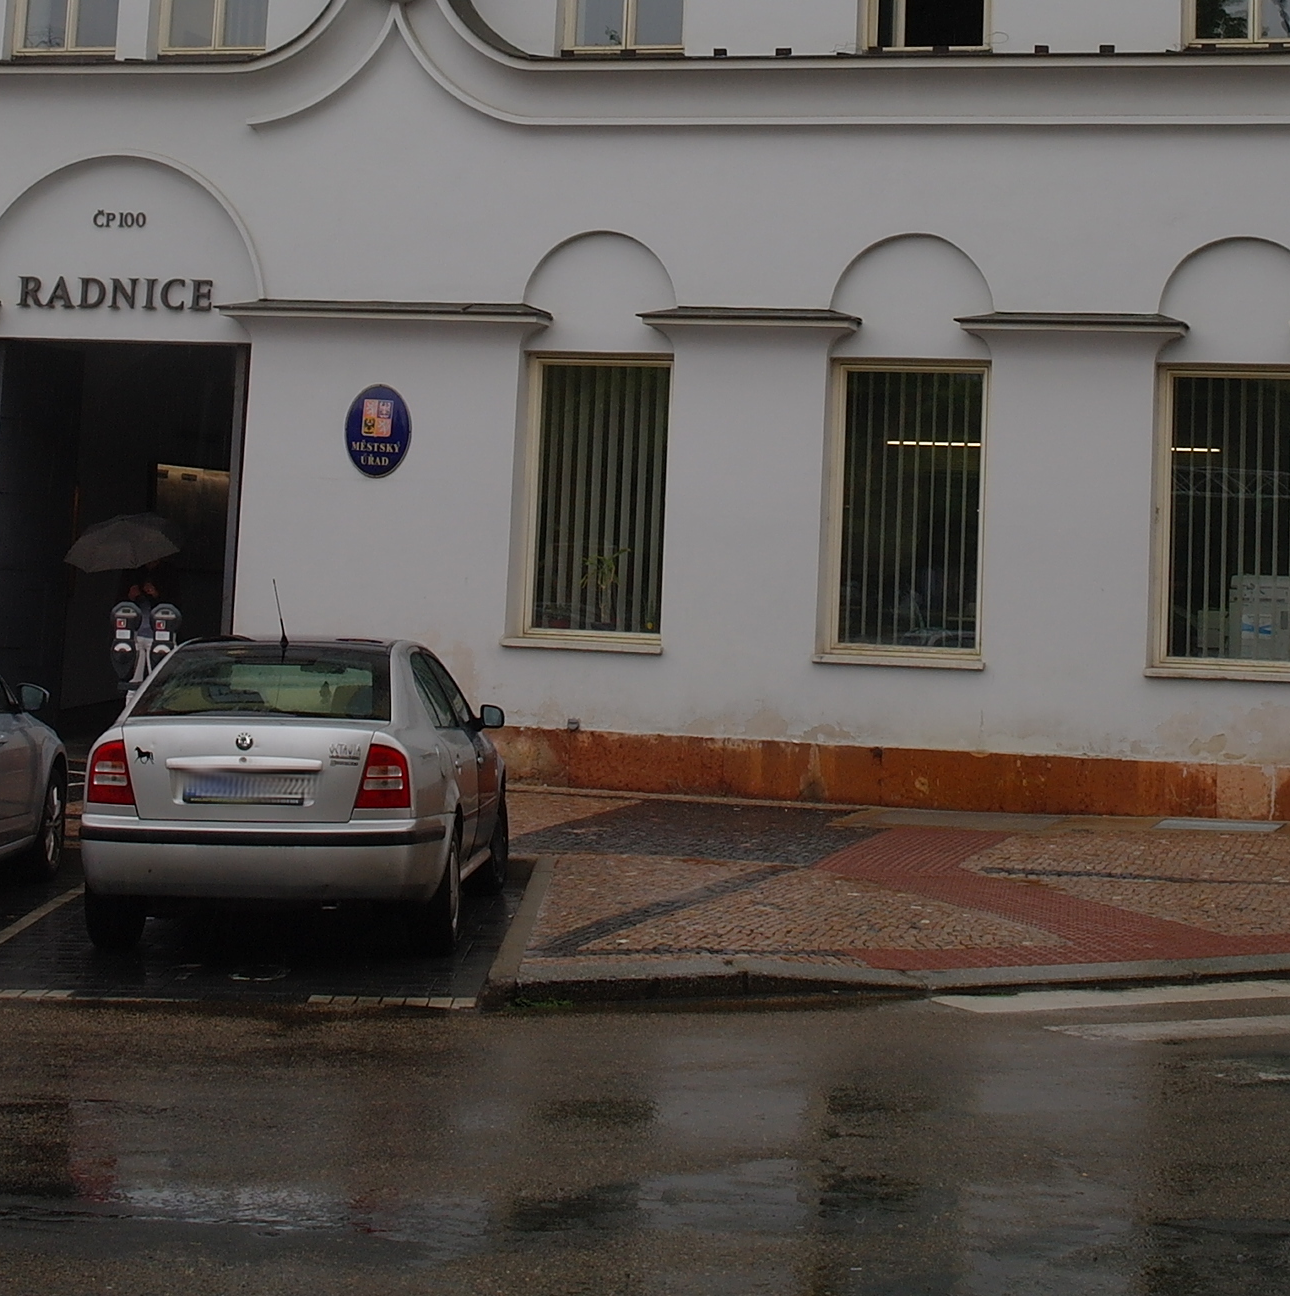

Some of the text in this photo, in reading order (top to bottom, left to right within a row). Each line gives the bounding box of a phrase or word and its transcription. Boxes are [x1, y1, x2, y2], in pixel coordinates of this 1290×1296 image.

[93, 209, 146, 228] ČP 100
[16, 275, 214, 312] RADNICE
[351, 440, 401, 453] MĚSTSKÝ
[360, 454, 390, 466] ÚŘAD
